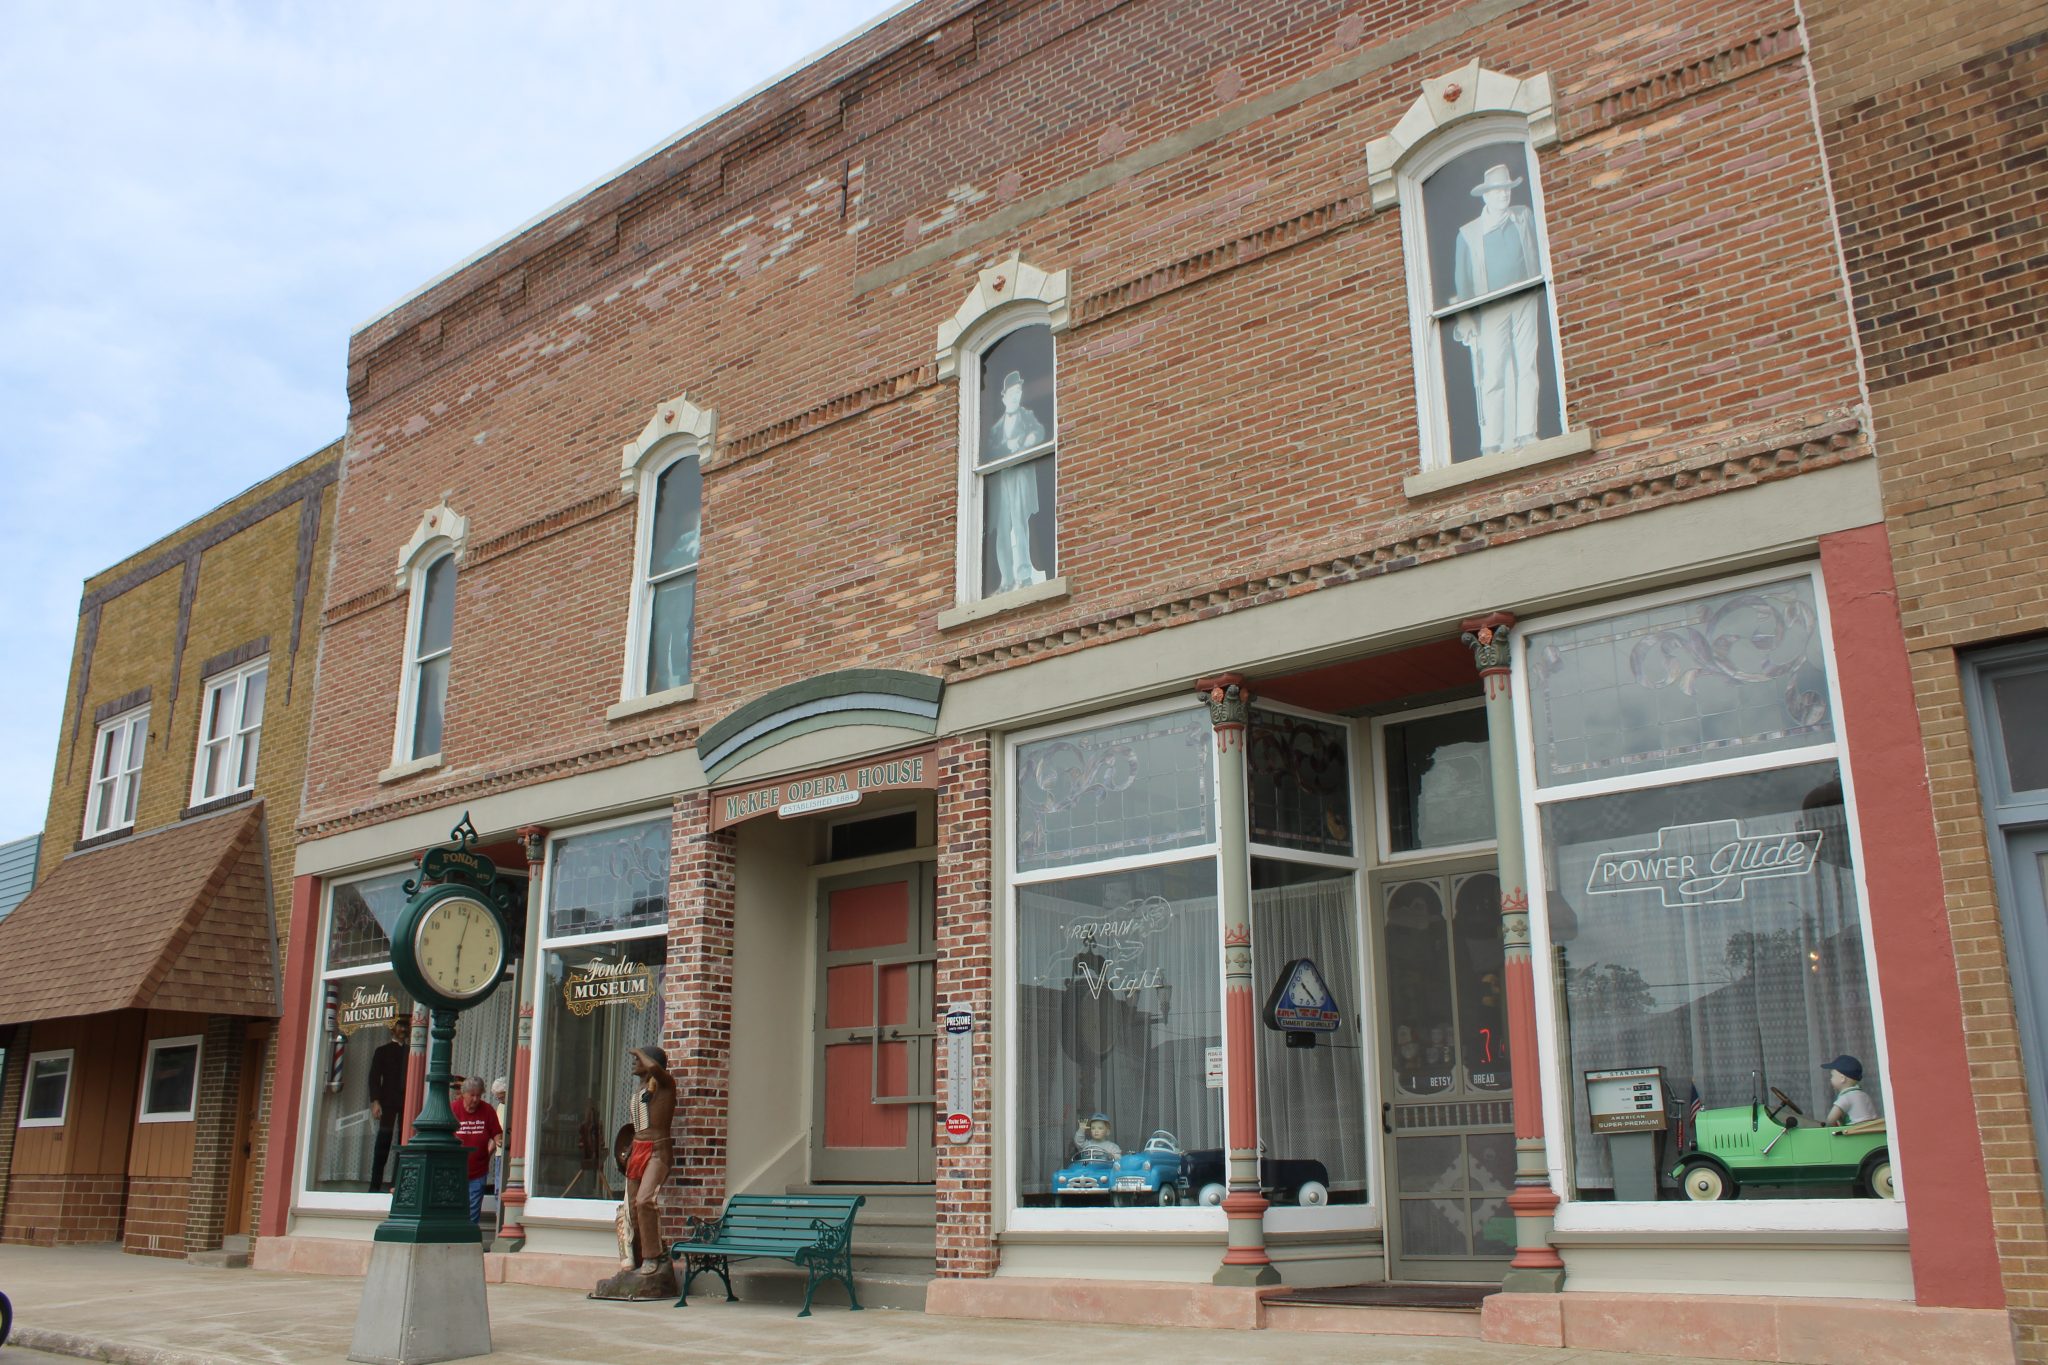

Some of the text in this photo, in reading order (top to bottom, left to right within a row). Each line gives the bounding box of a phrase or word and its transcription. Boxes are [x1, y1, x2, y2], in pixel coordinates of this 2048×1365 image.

[725, 757, 923, 821] McKEE OPERA HOUSE
[783, 794, 854, 813] ESTABLISHED 1884
[443, 853, 479, 868] FONDA
[1603, 856, 1696, 882] POWER
[443, 910, 451, 919] 11
[458, 906, 467, 917] 12
[431, 921, 440, 930] 10
[1071, 922, 1098, 939] RED
[485, 928, 491, 937] 2
[424, 937, 429, 946] 9
[488, 947, 494, 956] 3
[583, 955, 637, 982] Fonda
[438, 971, 443, 980] 7
[470, 975, 475, 984] 5
[1078, 959, 1114, 1000] V
[453, 978, 458, 987] 6
[574, 978, 646, 998] MUSEUM
[350, 984, 389, 1009] Fonda
[344, 1006, 394, 1022] MUSEUM
[946, 1016, 971, 1026] PRESTONE
[1610, 1069, 1650, 1077] STANDARD
[1430, 1074, 1495, 1087] BETSY BREAD
